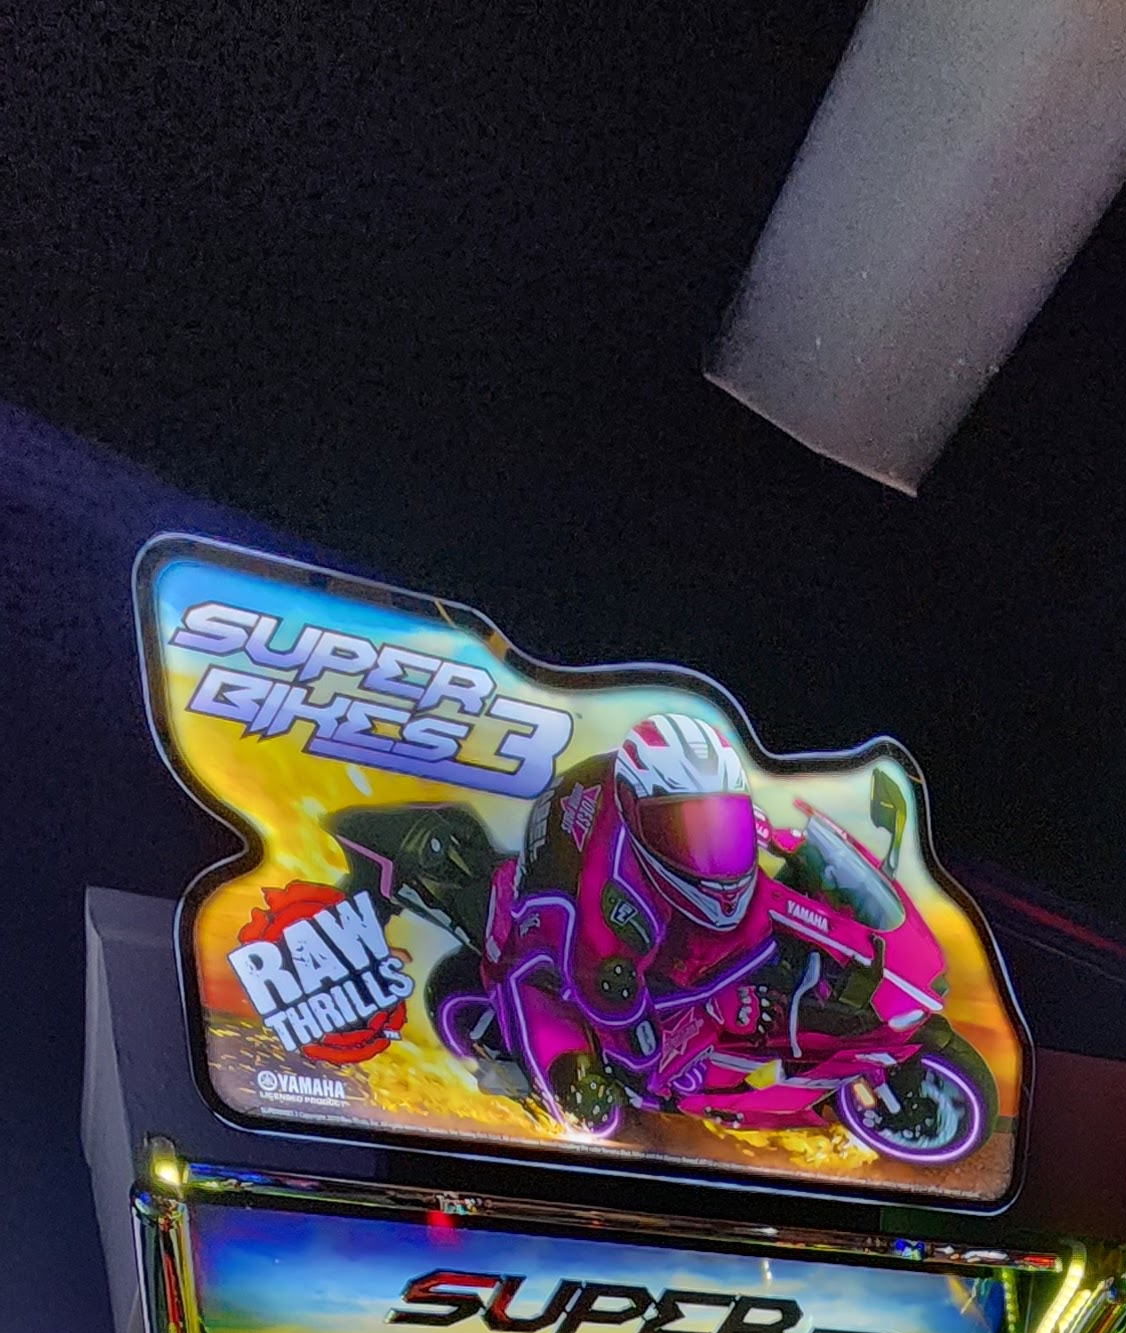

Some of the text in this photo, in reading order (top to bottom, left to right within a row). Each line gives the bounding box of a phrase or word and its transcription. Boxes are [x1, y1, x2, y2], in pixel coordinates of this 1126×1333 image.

[168, 600, 497, 717] SUPER
[185, 664, 573, 800] BIKES 3
[228, 890, 390, 1016] RAW
[786, 899, 829, 934] YAMAHA
[264, 957, 415, 1052] THRILLS
[277, 1072, 346, 1099] YAMAHA
